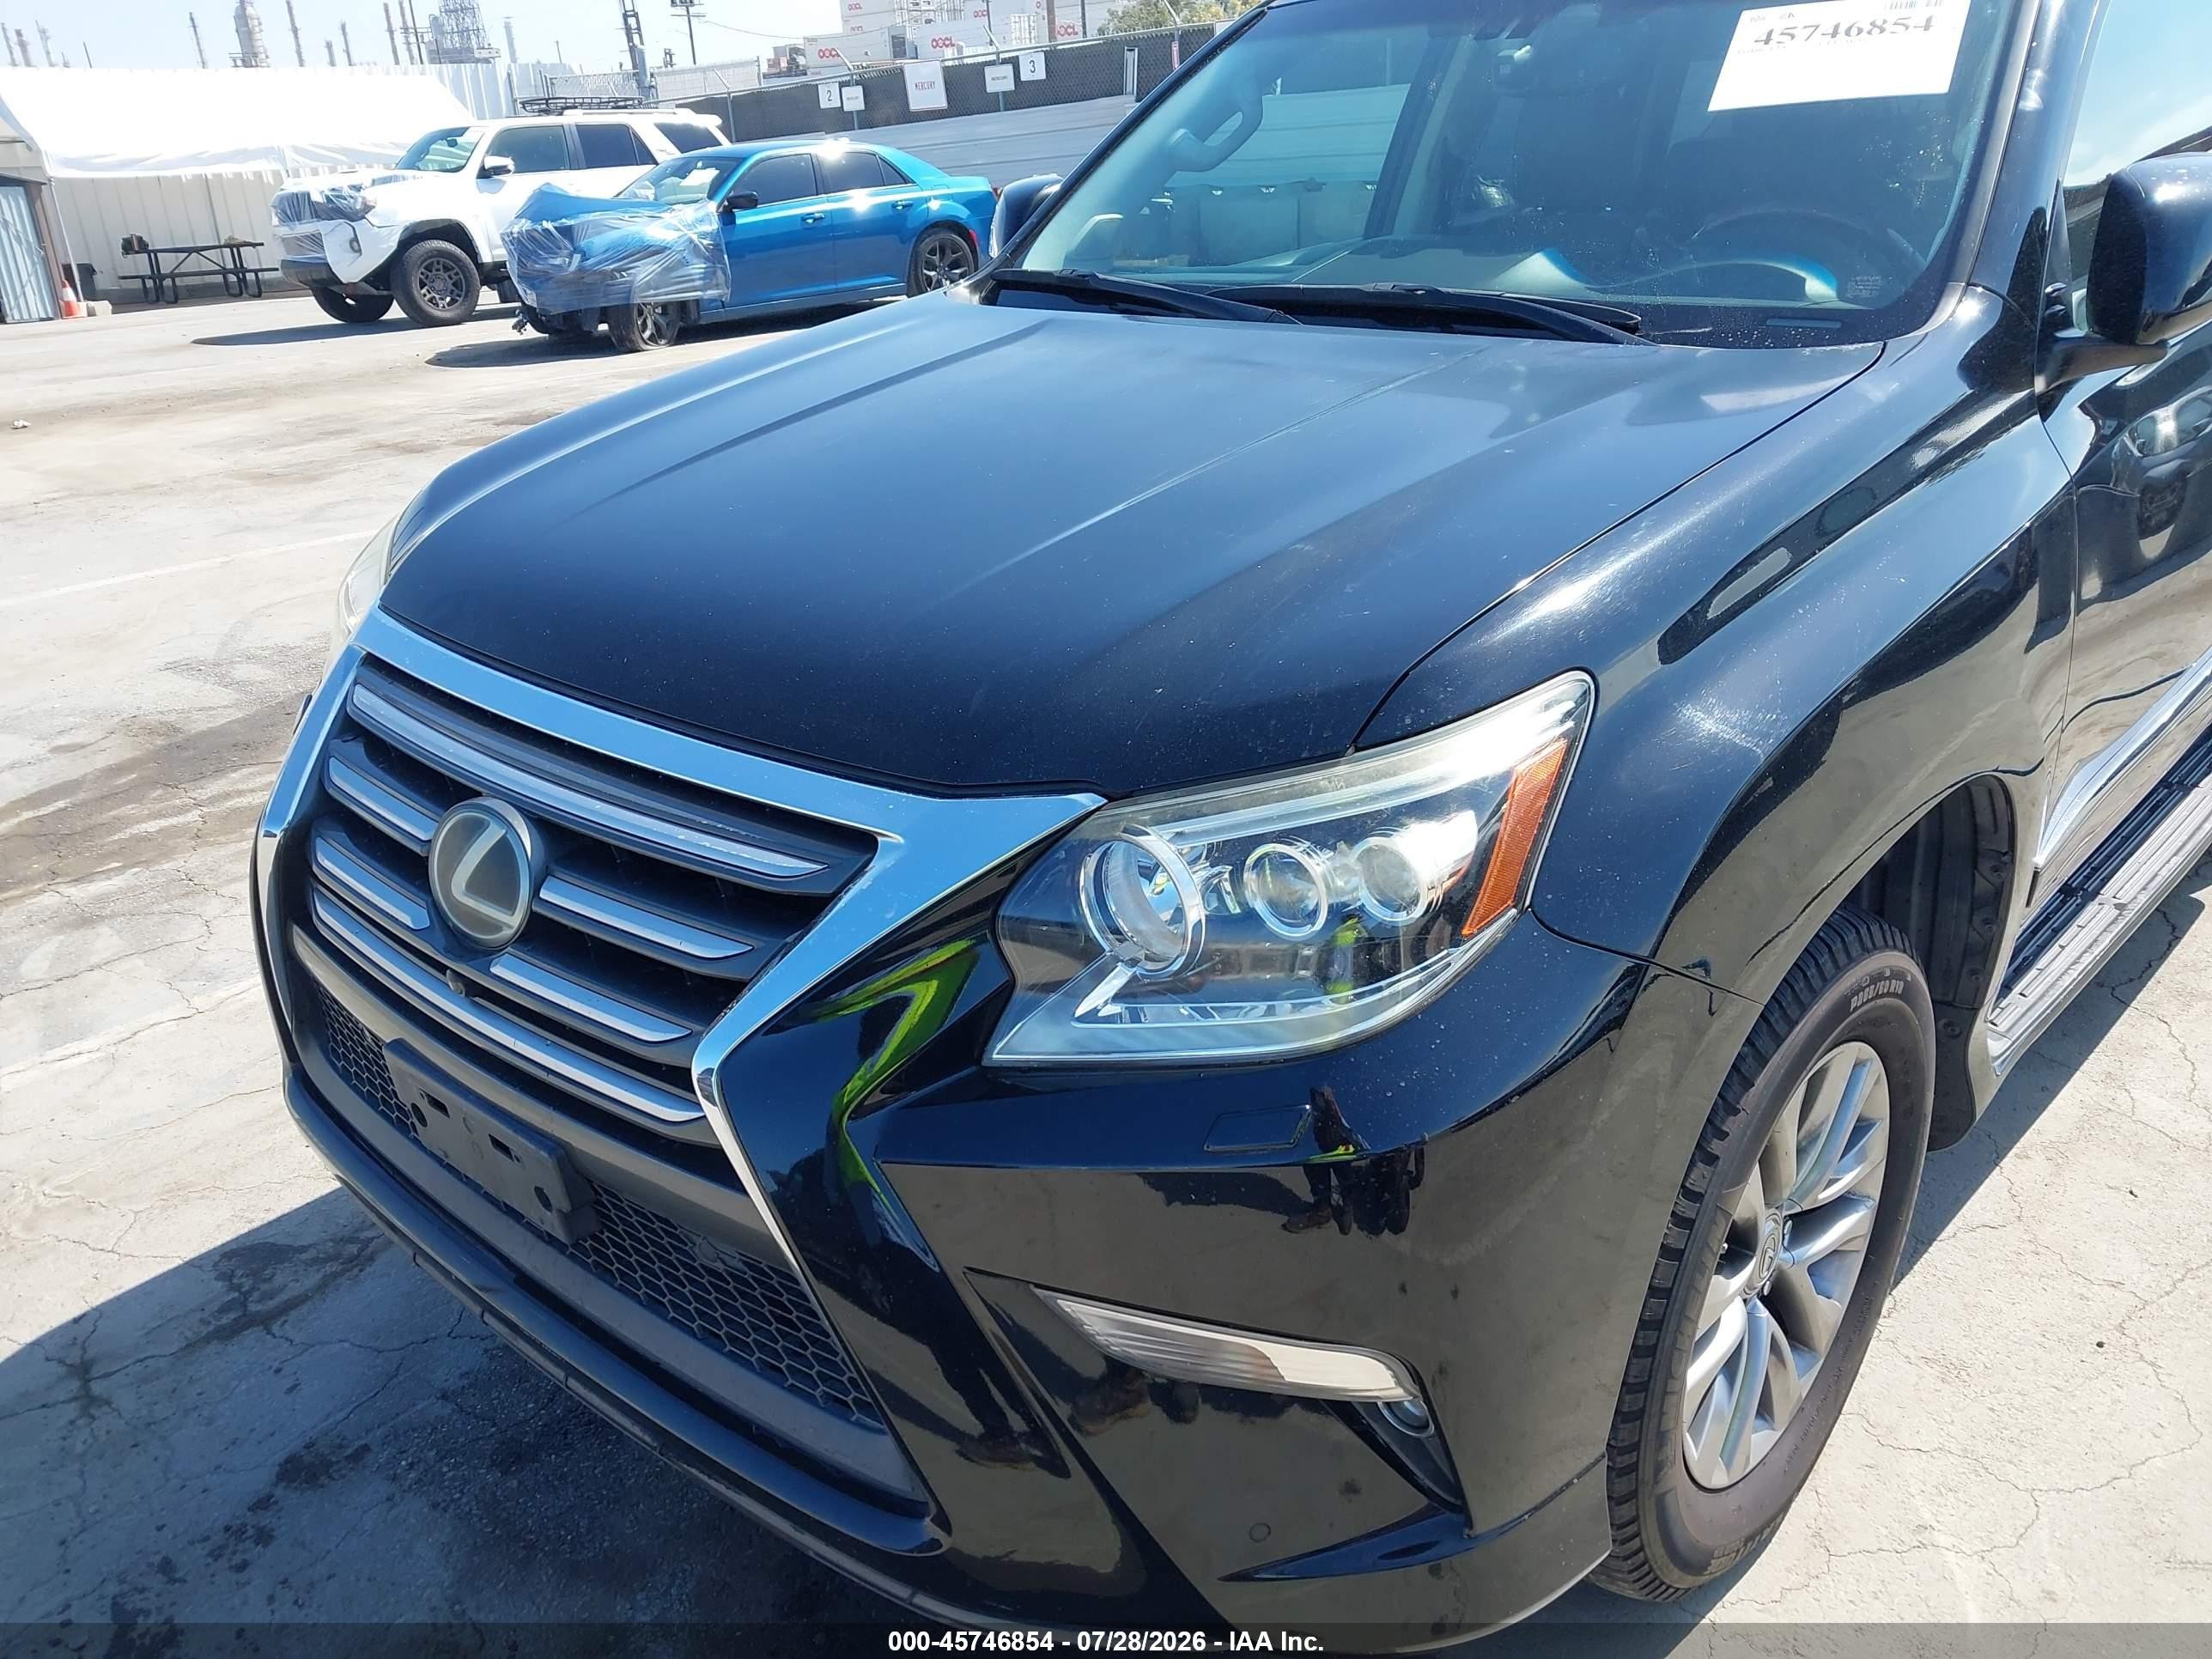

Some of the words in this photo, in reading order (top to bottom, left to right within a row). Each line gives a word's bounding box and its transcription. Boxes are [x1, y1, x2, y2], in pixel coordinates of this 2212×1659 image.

[974, 9, 988, 18] OOC
[1754, 15, 1934, 46] 45746854
[931, 36, 955, 49] OOCL
[1029, 60, 1036, 74] 3
[915, 81, 935, 91] MERCURY
[826, 89, 833, 102] 2
